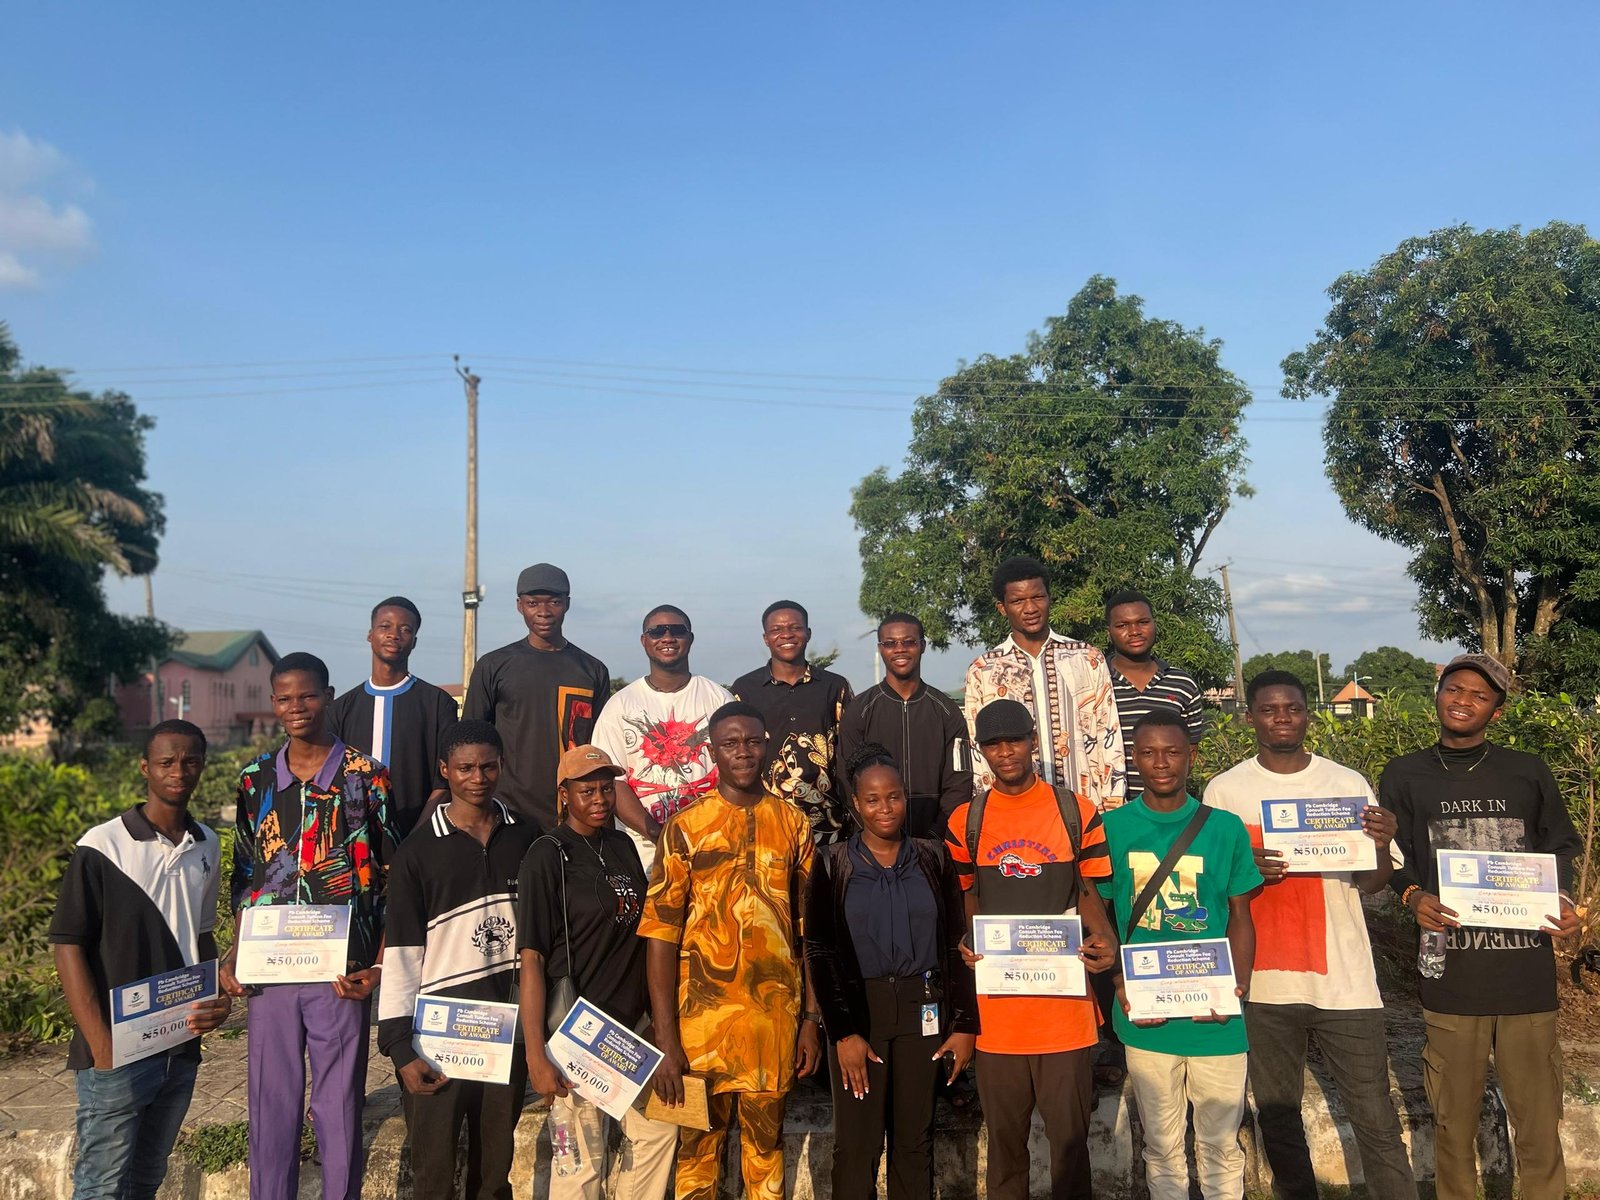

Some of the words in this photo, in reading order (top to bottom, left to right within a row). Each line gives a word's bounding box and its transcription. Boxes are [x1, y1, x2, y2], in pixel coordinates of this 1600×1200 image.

[1440, 800, 1482, 814] DARK
[1487, 800, 1506, 812] IN
[1486, 875, 1540, 884] CERTIFICATE
[1166, 962, 1216, 970] CERTIFICATE
[156, 984, 203, 1003] CERTIFICATE
[175, 994, 195, 1003] AWARD
[453, 1024, 499, 1034] CERTIFICATE
[598, 1042, 637, 1072] CERTIFICATE
[609, 1056, 627, 1071] AWARD
